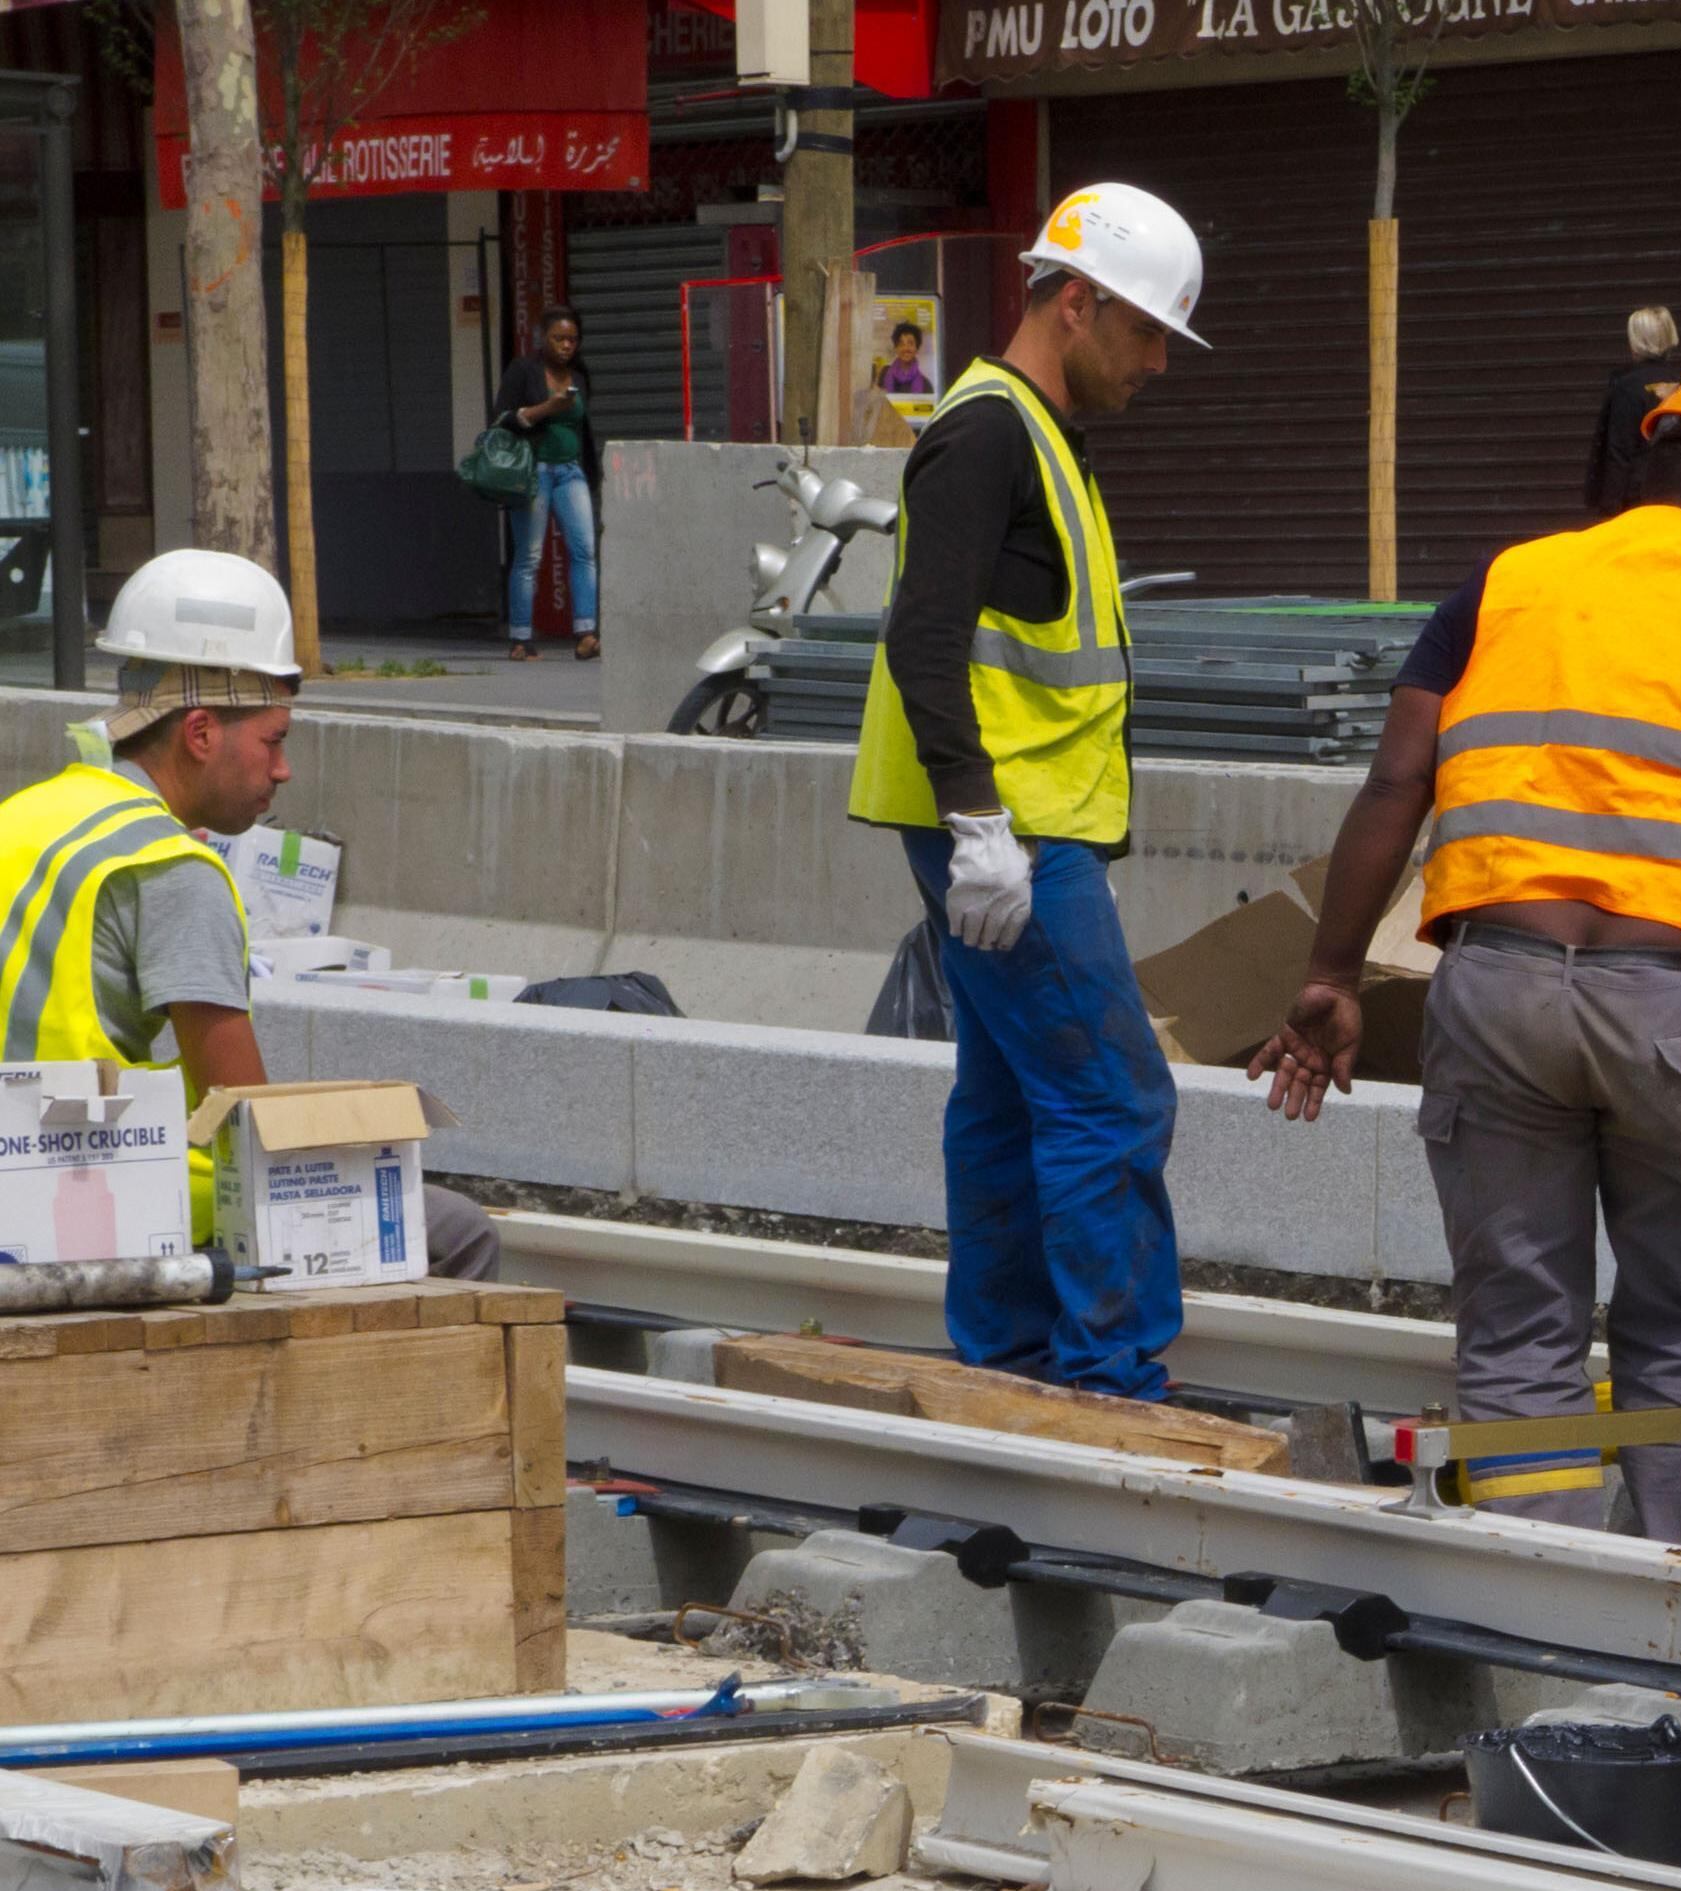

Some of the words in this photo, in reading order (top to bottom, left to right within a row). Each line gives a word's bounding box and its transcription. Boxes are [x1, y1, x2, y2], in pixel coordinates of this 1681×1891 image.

[963, 3, 1044, 59] PMU
[1060, 0, 1156, 50] LOTO
[343, 134, 452, 183] ROTISSERIE
[256, 852, 333, 881] RAECH
[0, 1131, 83, 1156] ONE-SHOT
[88, 1126, 166, 1150] CRUCIBLE
[268, 1176, 306, 1189] LUTING
[309, 1173, 339, 1185] PASTE
[269, 1188, 302, 1202] PASTA
[304, 1184, 363, 1199] SELLADORA
[303, 1252, 329, 1276] 12
